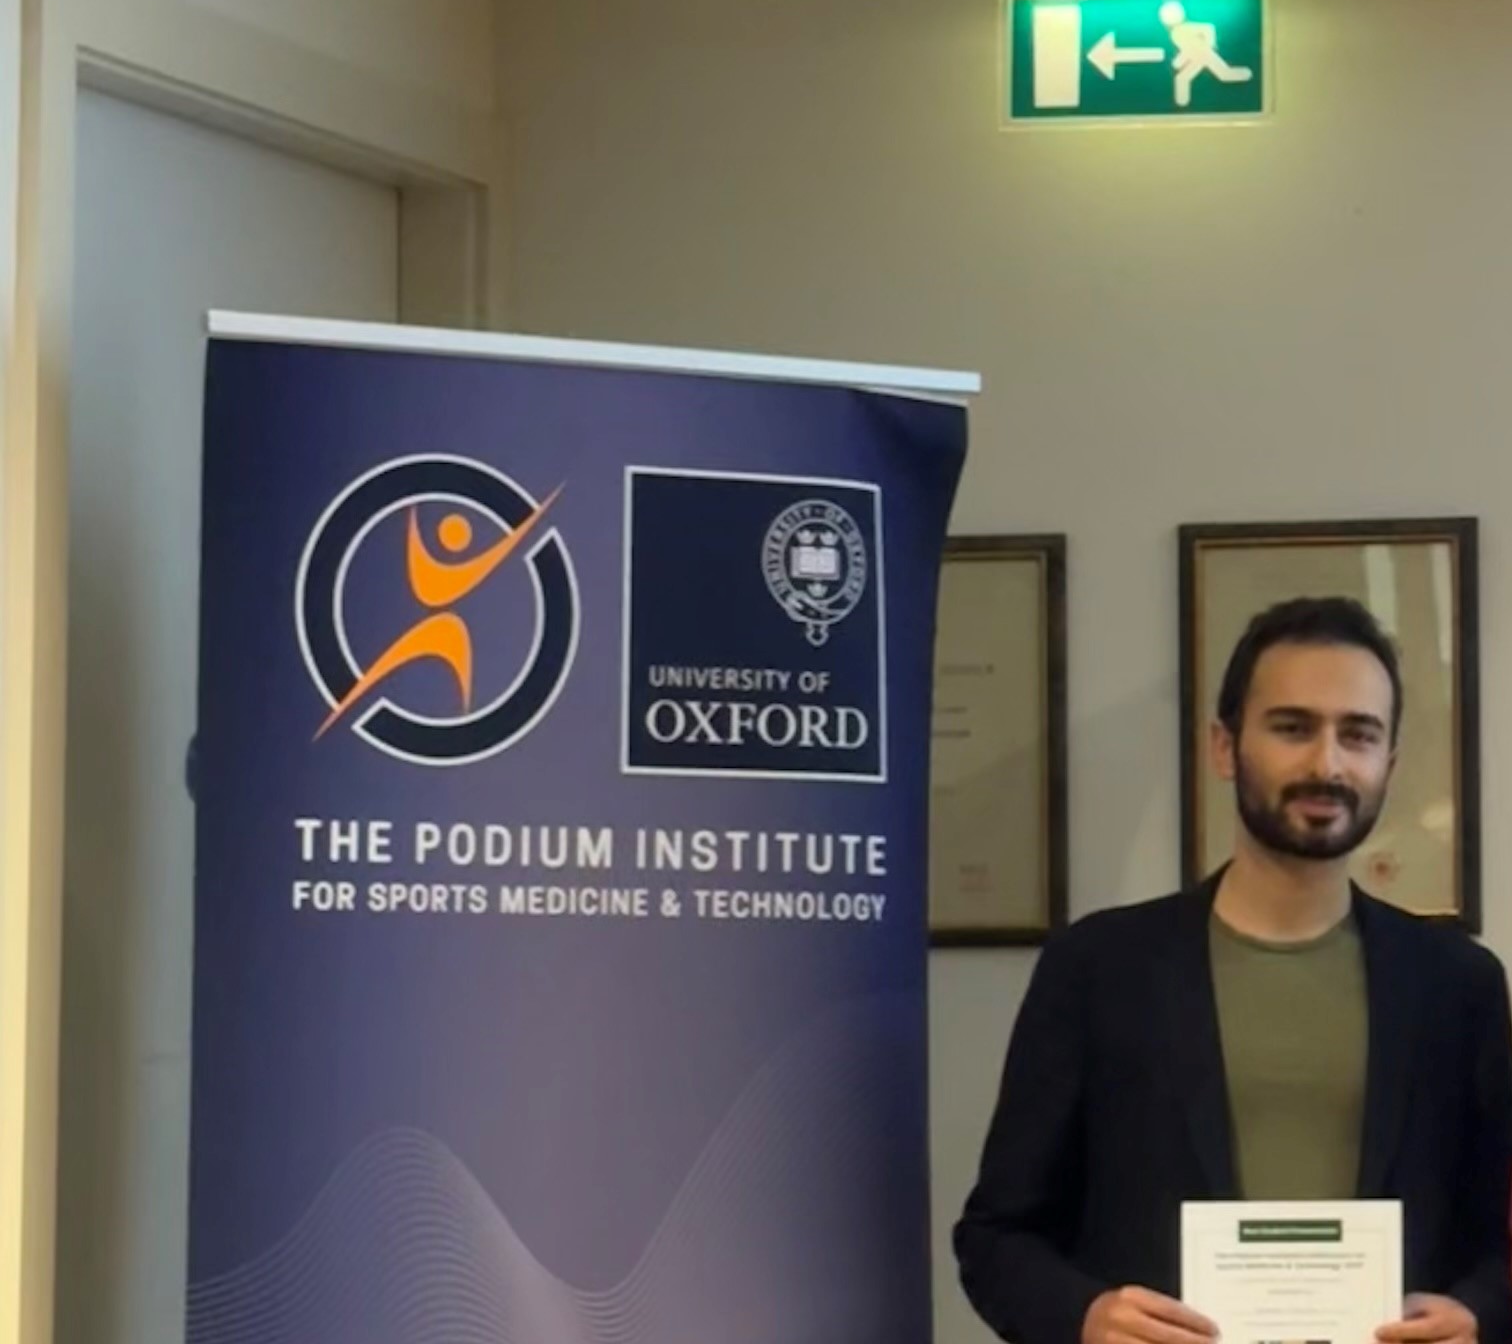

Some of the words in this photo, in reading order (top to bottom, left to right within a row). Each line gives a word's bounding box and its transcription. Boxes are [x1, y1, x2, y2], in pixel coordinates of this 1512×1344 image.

[649, 665, 791, 691] UNIVERSITY
[798, 670, 829, 693] OF
[645, 699, 868, 748] OXFORD
[294, 818, 393, 863] THE
[415, 822, 613, 868] PODIUM
[636, 828, 886, 875] INSTITUTE
[292, 881, 356, 911] FOR
[368, 882, 488, 914] SPORTS
[500, 885, 648, 916] MEDICINE
[660, 889, 681, 917] &
[692, 888, 885, 921] TECHNOLOGY
